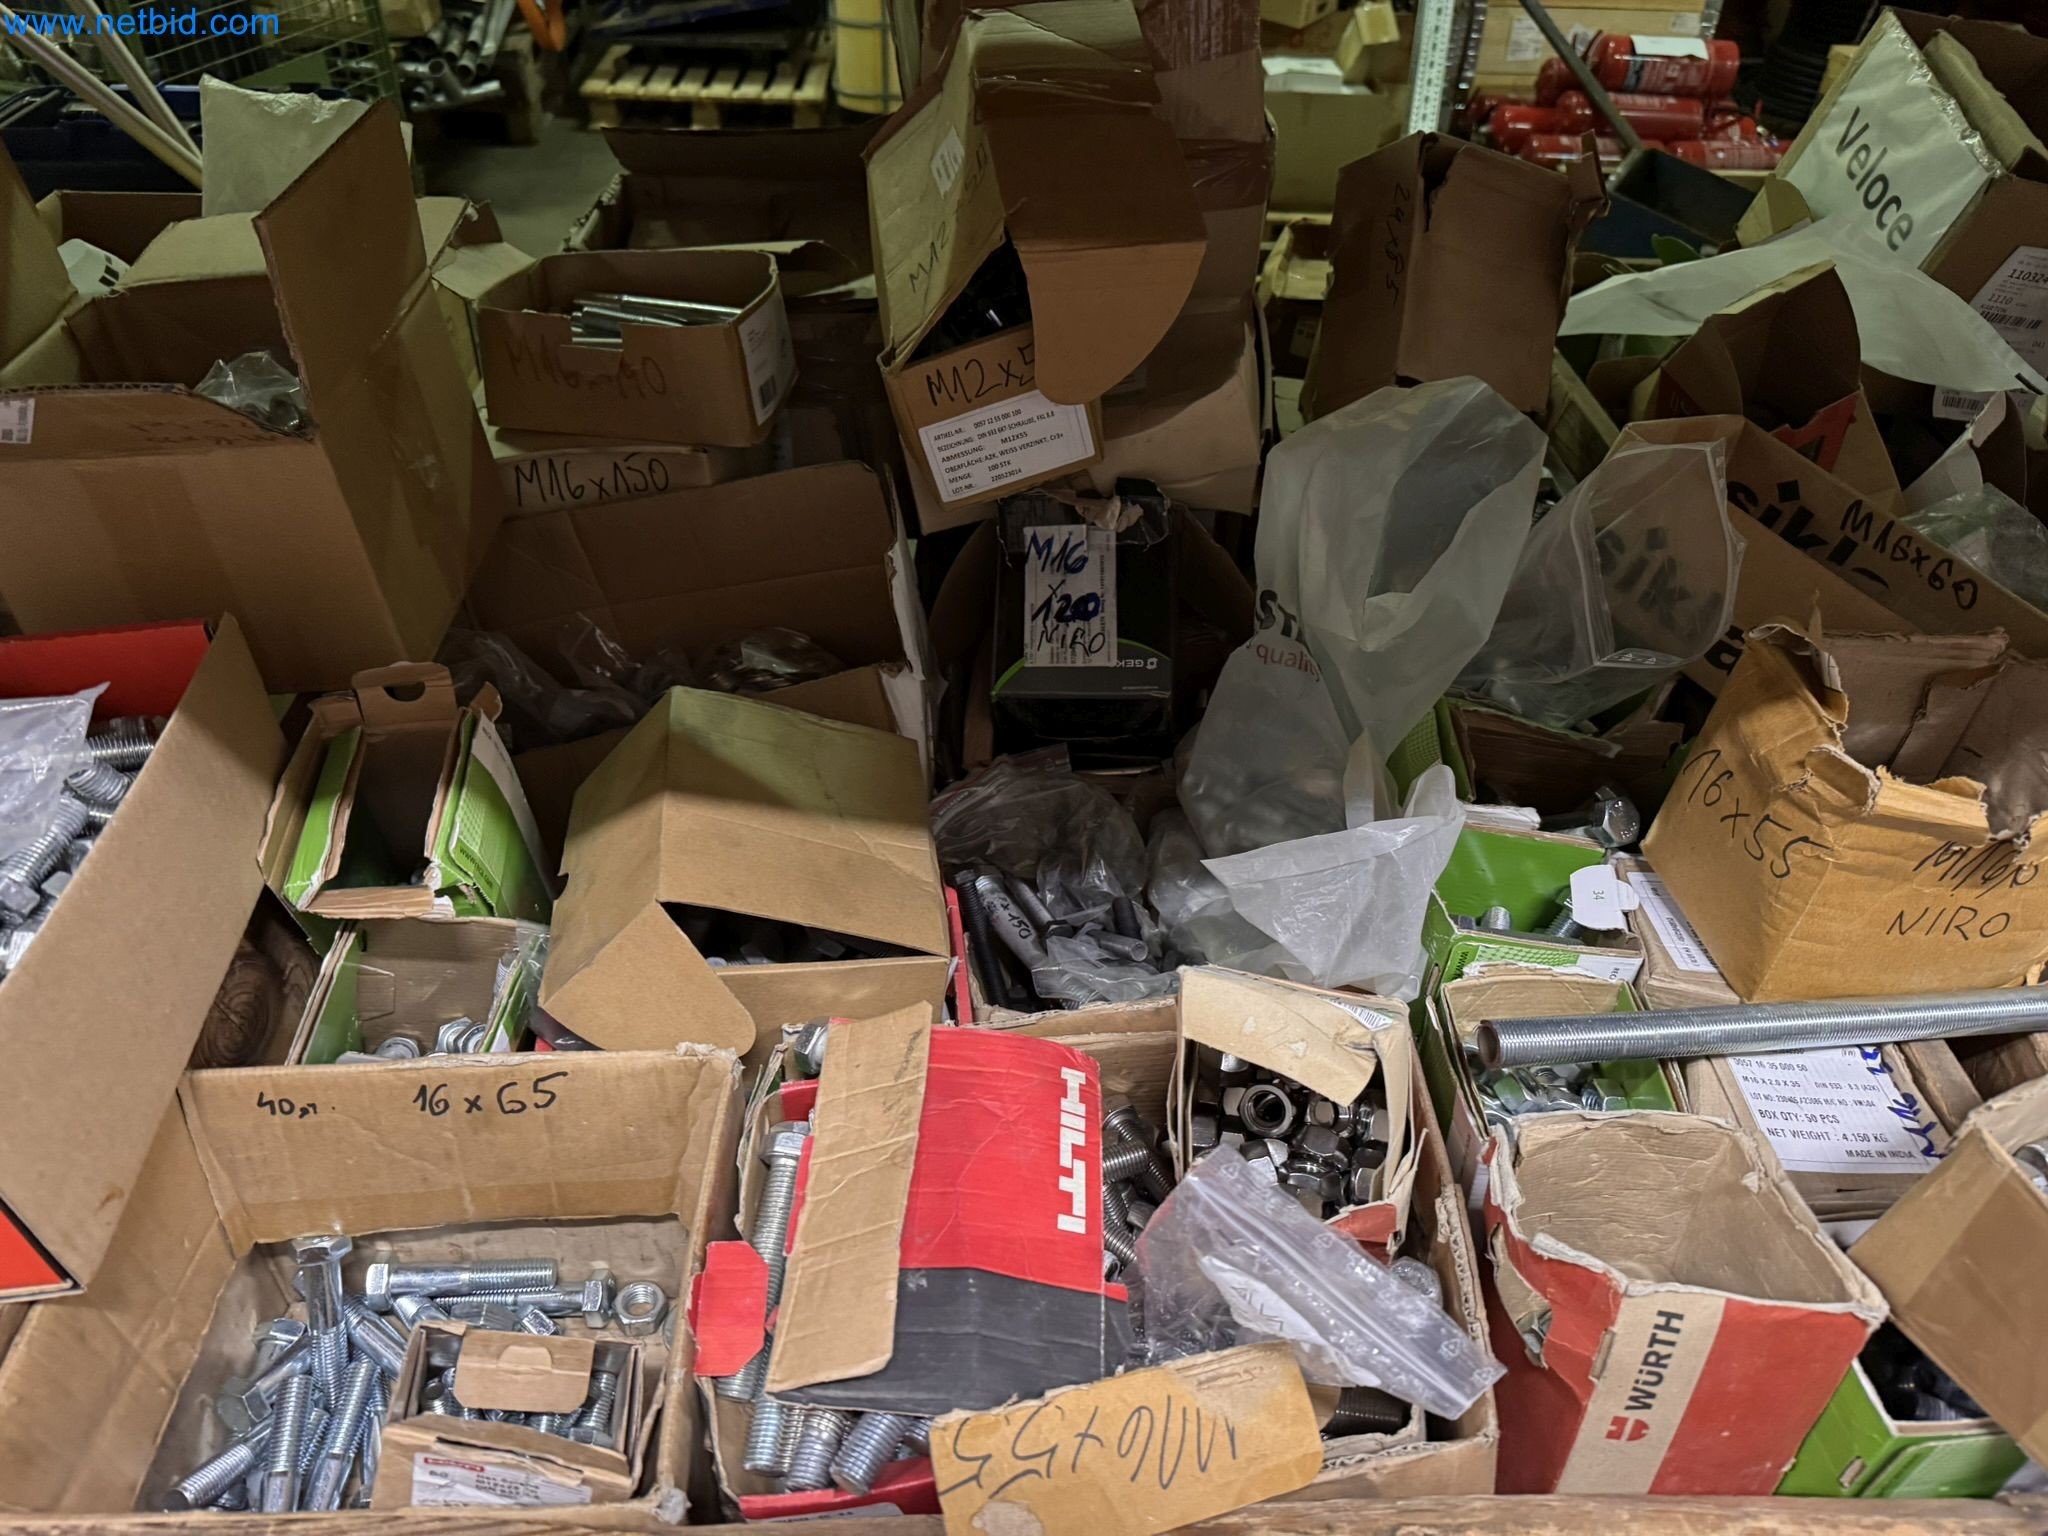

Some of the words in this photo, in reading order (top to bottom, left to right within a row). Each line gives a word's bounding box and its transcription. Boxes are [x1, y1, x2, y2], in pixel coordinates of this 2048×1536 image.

[1836, 106, 1914, 252] Veloce
[999, 443, 1018, 457] WEISS
[513, 451, 669, 507] M16x150
[1025, 530, 1089, 574] M16
[1839, 499, 1979, 611] M16x60
[1592, 889, 1605, 901] 34
[1886, 905, 2011, 941] NIRO
[1798, 1063, 1808, 1073] 50
[412, 1083, 450, 1116] 16
[464, 1094, 483, 1114] x
[496, 1071, 569, 1115] 65
[1758, 1108, 1777, 1121] BOX
[1779, 1110, 1804, 1123] QTY:
[1806, 1112, 1818, 1124] 50
[1821, 1114, 1840, 1124] PCS
[1767, 1127, 1785, 1139] NET
[1791, 1128, 1831, 1142] WEIGHT
[1842, 1132, 1870, 1144] 4.150
[1873, 1133, 1889, 1143] KG
[1056, 1065, 1087, 1235] HILTI
[1845, 1149, 1874, 1159] MADE
[1876, 1150, 1887, 1159] IN
[1888, 1150, 1917, 1160] INDIA
[1623, 1309, 1686, 1412] WÜRTH
